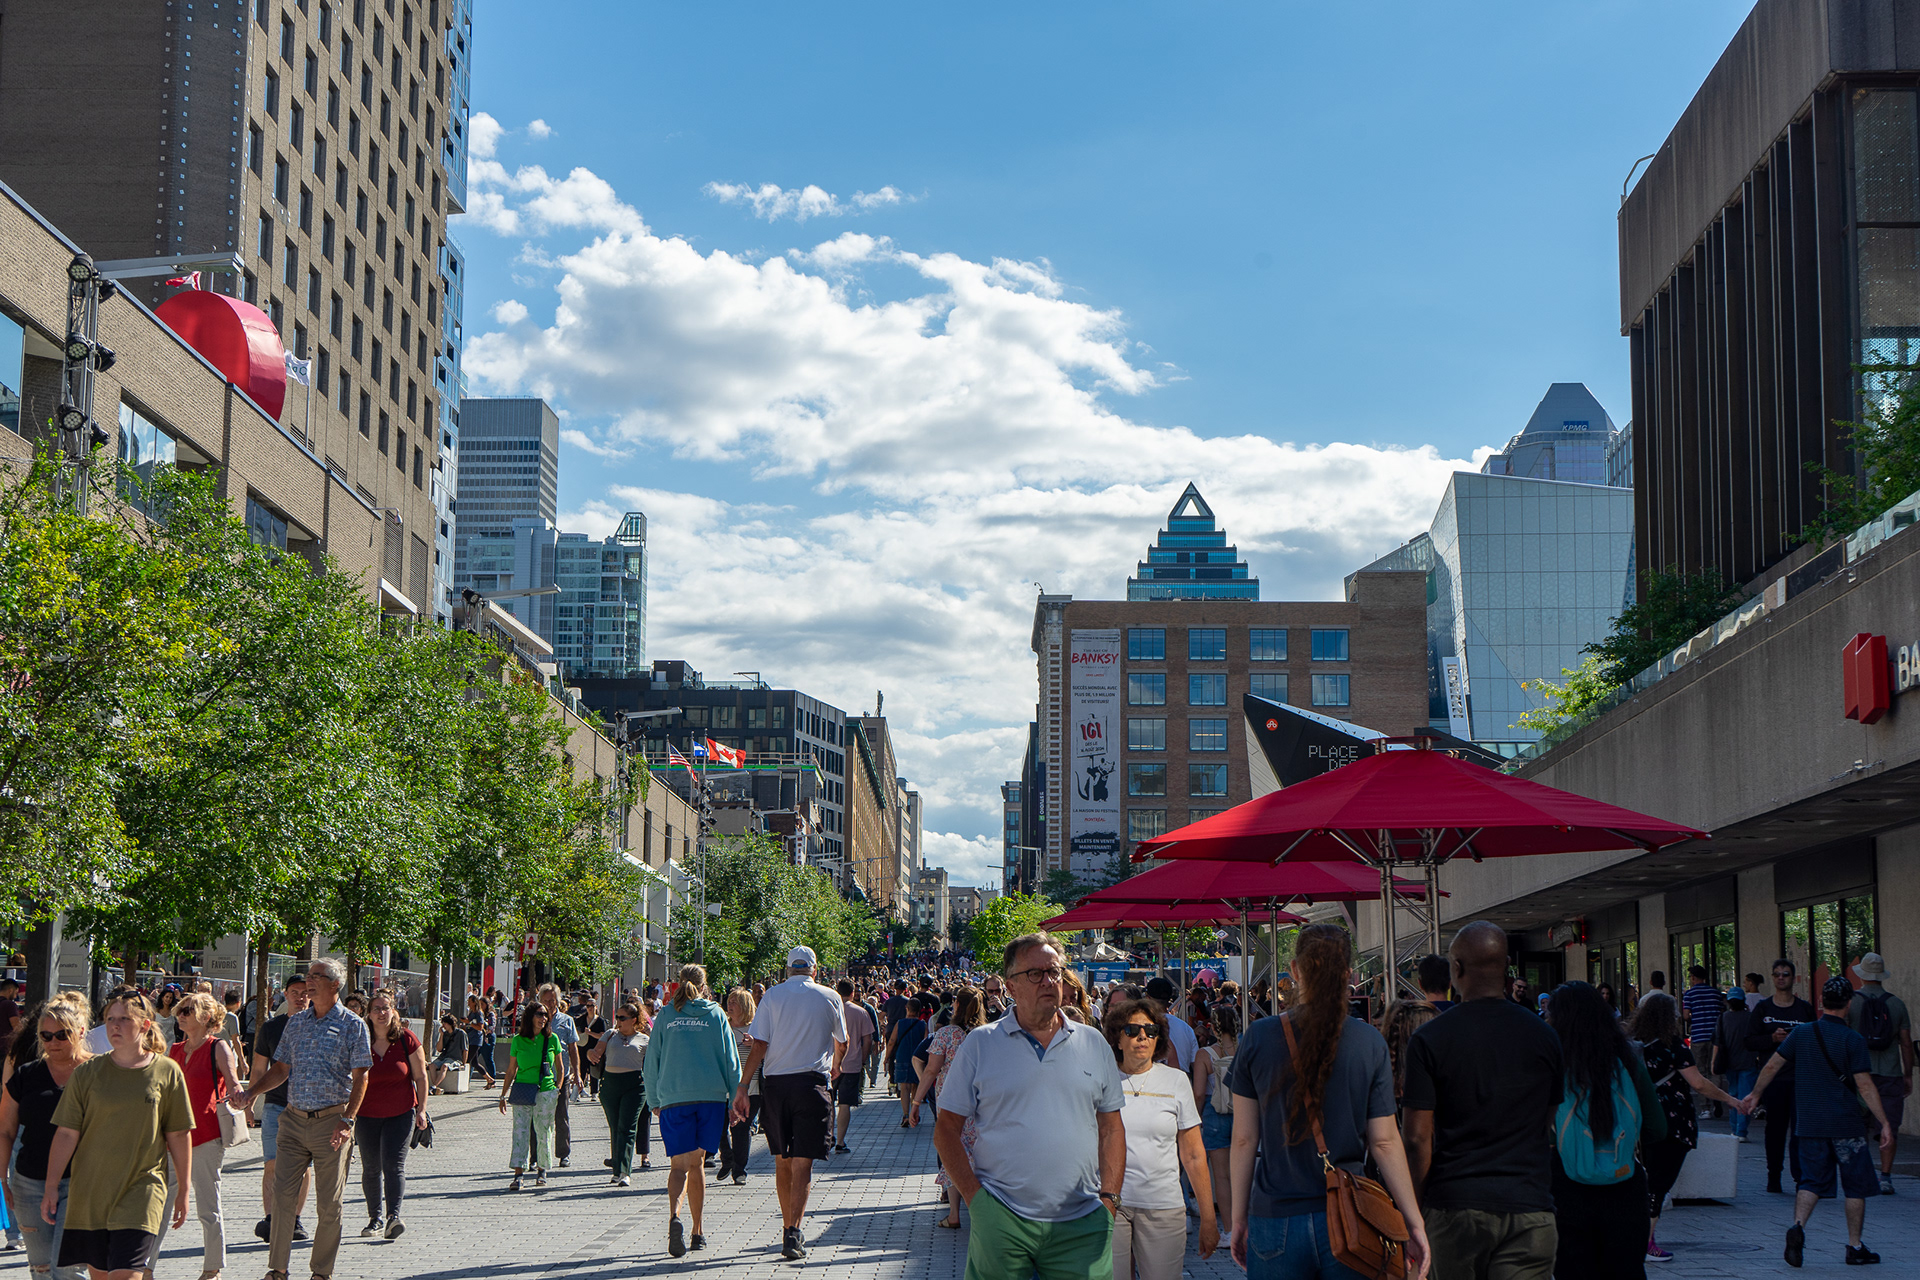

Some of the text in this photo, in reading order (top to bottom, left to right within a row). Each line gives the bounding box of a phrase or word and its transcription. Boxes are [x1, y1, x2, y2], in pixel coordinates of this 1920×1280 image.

[1071, 652, 1119, 665] BANKSY
[1308, 745, 1359, 758] PLACE
[211, 959, 237, 969] FAVORIS
